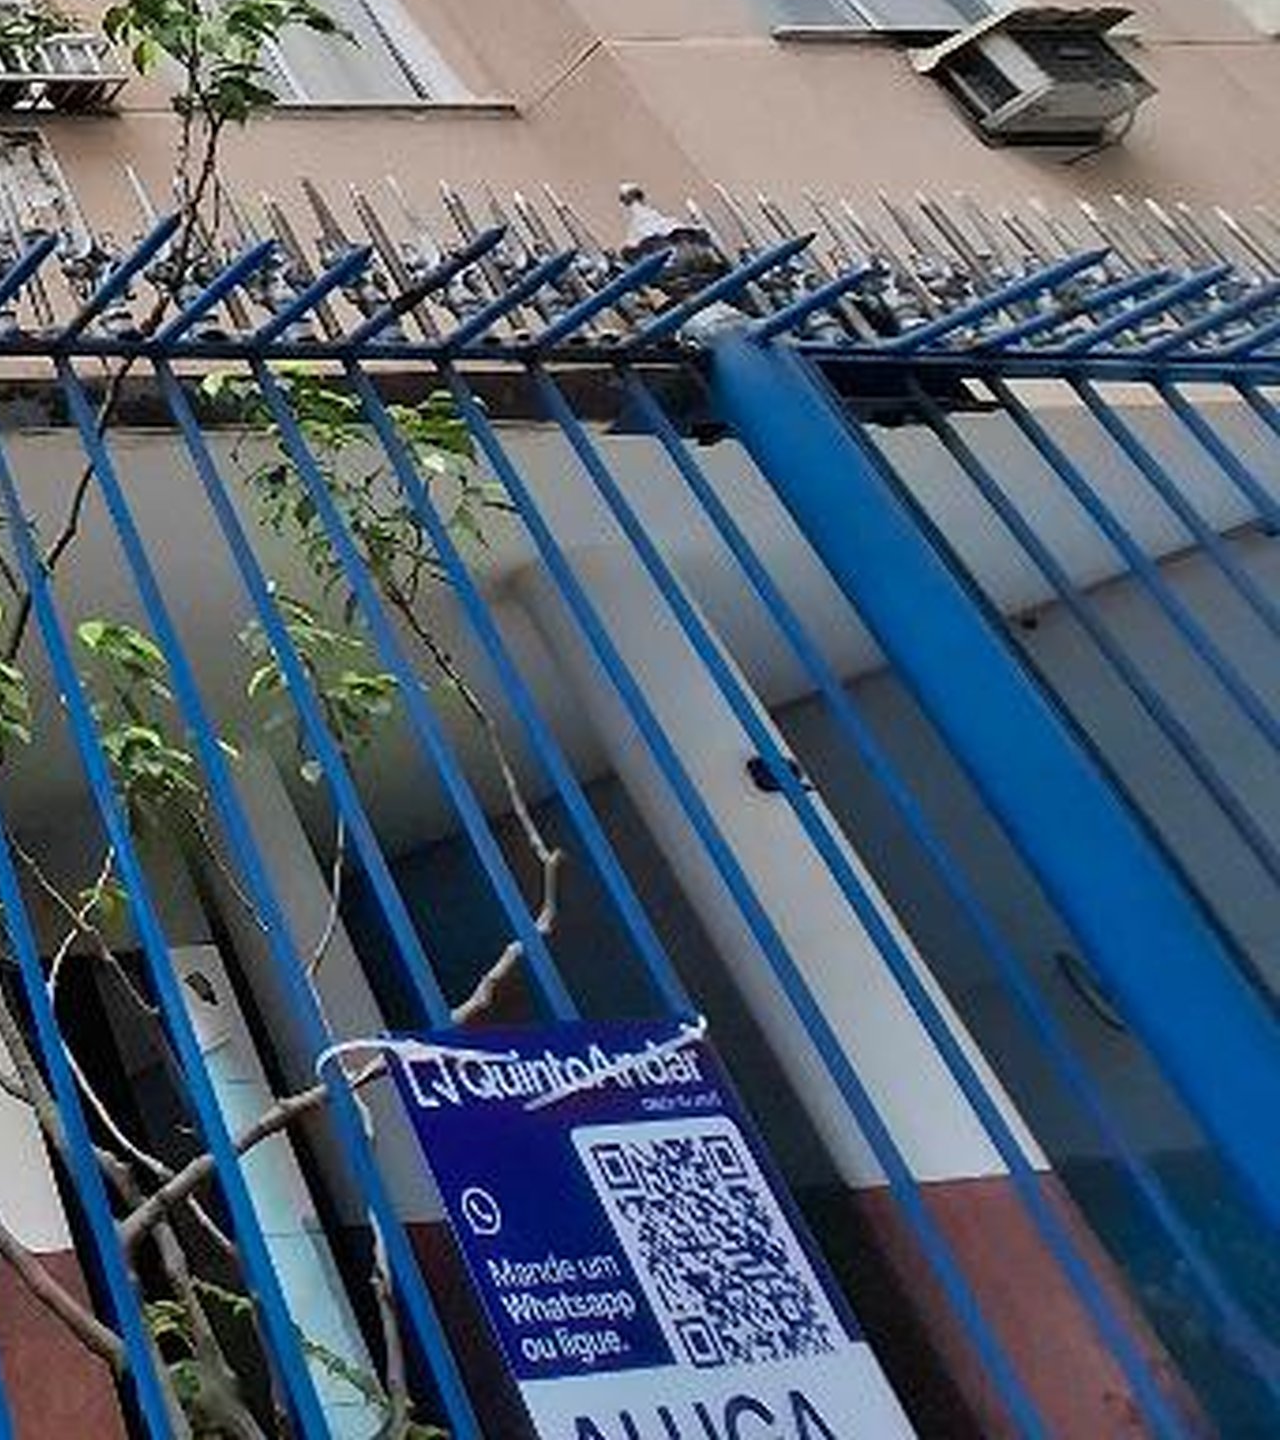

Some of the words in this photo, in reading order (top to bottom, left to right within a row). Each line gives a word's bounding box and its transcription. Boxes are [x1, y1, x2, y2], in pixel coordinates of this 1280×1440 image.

[456, 1039, 703, 1100] QuintoAndar
[487, 1252, 577, 1287] Mande
[578, 1255, 622, 1280] um
[521, 1336, 557, 1362] ou
[553, 1326, 631, 1363] ligue.
